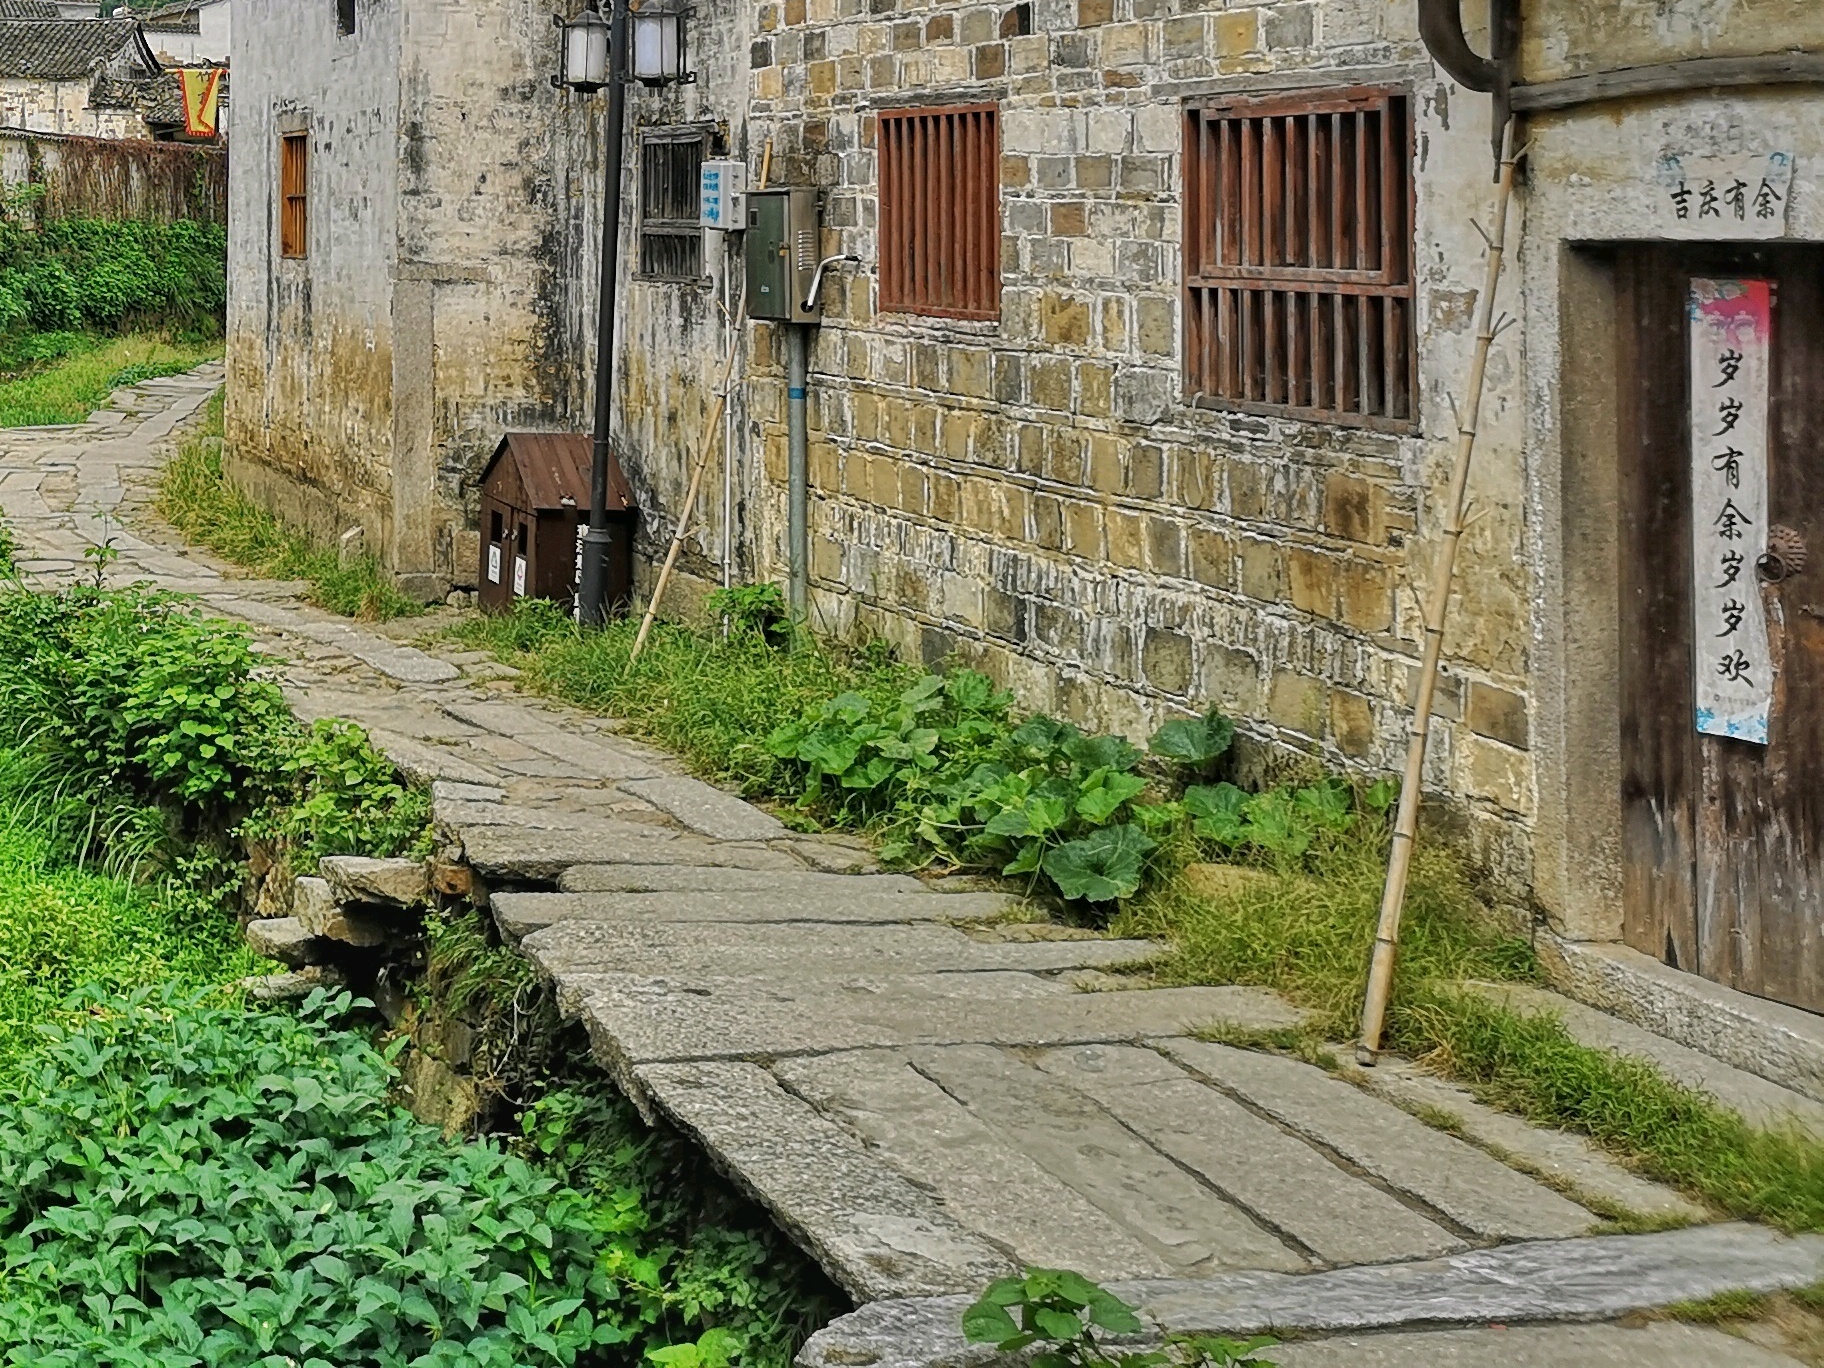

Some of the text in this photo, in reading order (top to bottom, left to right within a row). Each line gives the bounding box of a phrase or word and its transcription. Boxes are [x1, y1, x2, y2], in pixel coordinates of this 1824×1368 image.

[1670, 177, 1782, 221] 吉庆有余
[1711, 348, 1755, 688] 岁岁有余岁岁欢
